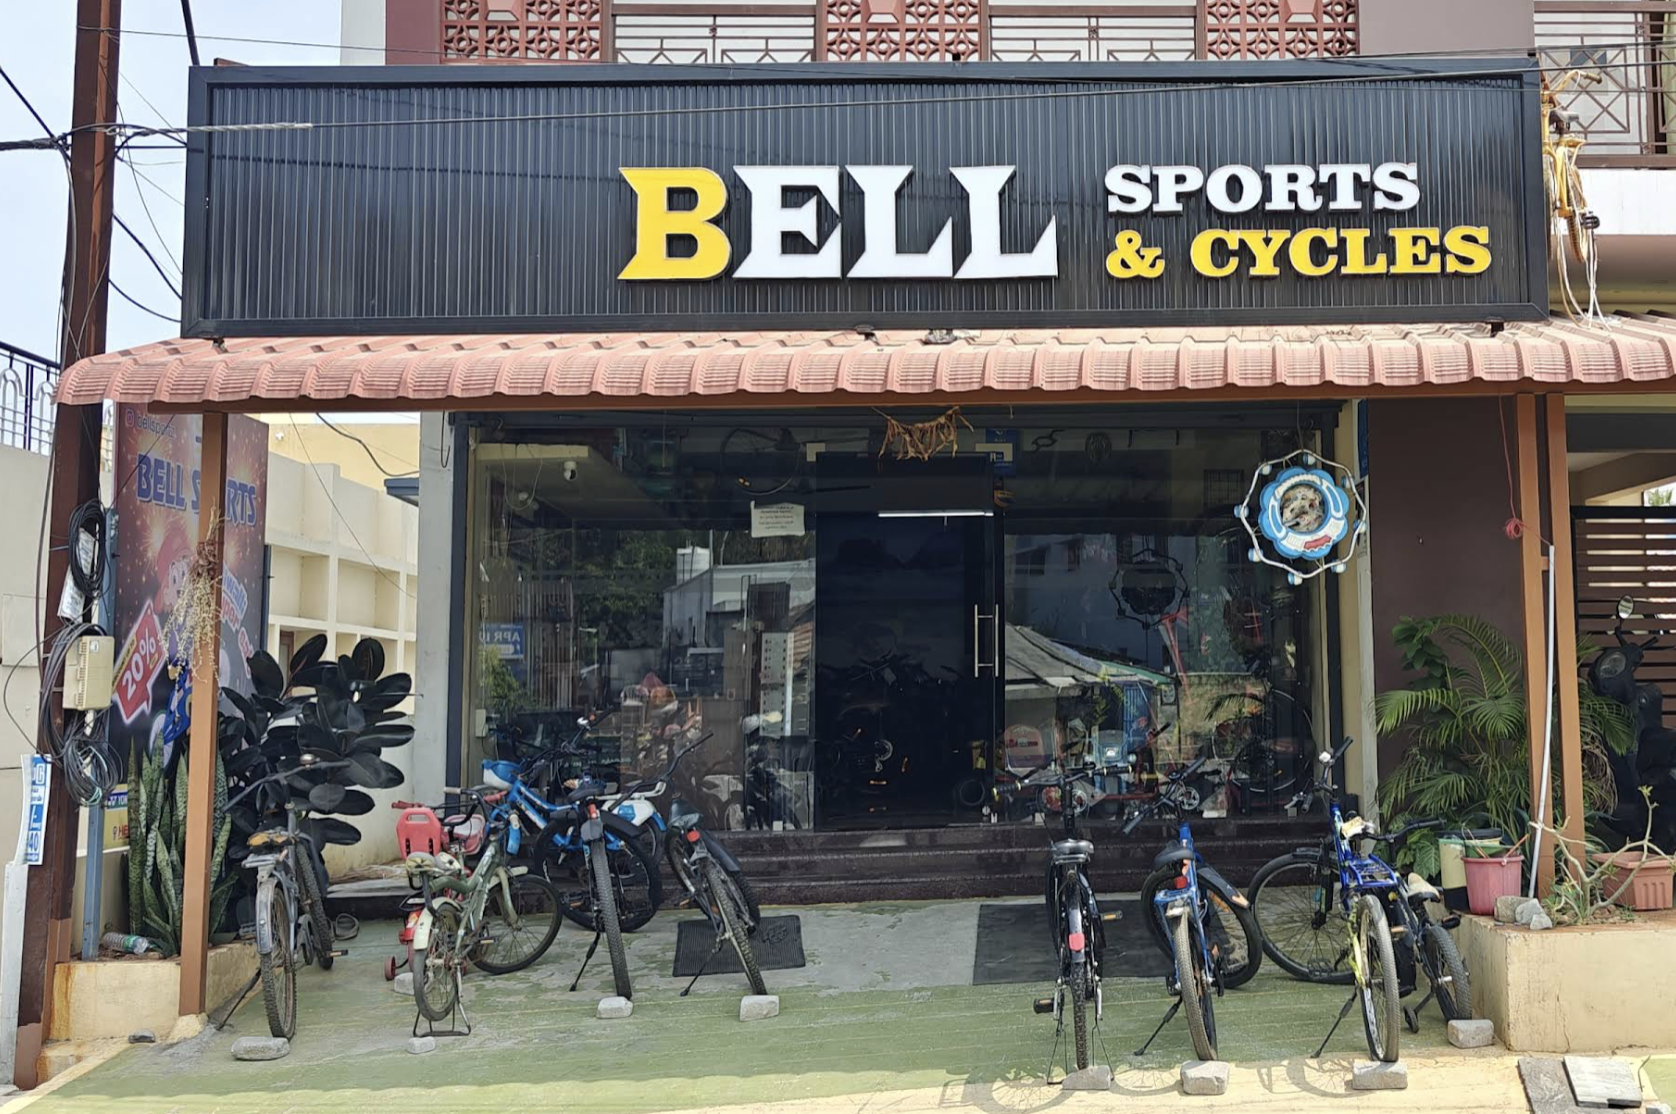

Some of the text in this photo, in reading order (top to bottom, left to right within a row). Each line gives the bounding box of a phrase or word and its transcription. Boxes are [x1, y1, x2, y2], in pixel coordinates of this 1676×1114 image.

[1105, 162, 1421, 215] SPORTS
[618, 164, 1059, 281] BELL
[1106, 225, 1493, 281] & CYCLES
[136, 452, 258, 528] BELL SRTS
